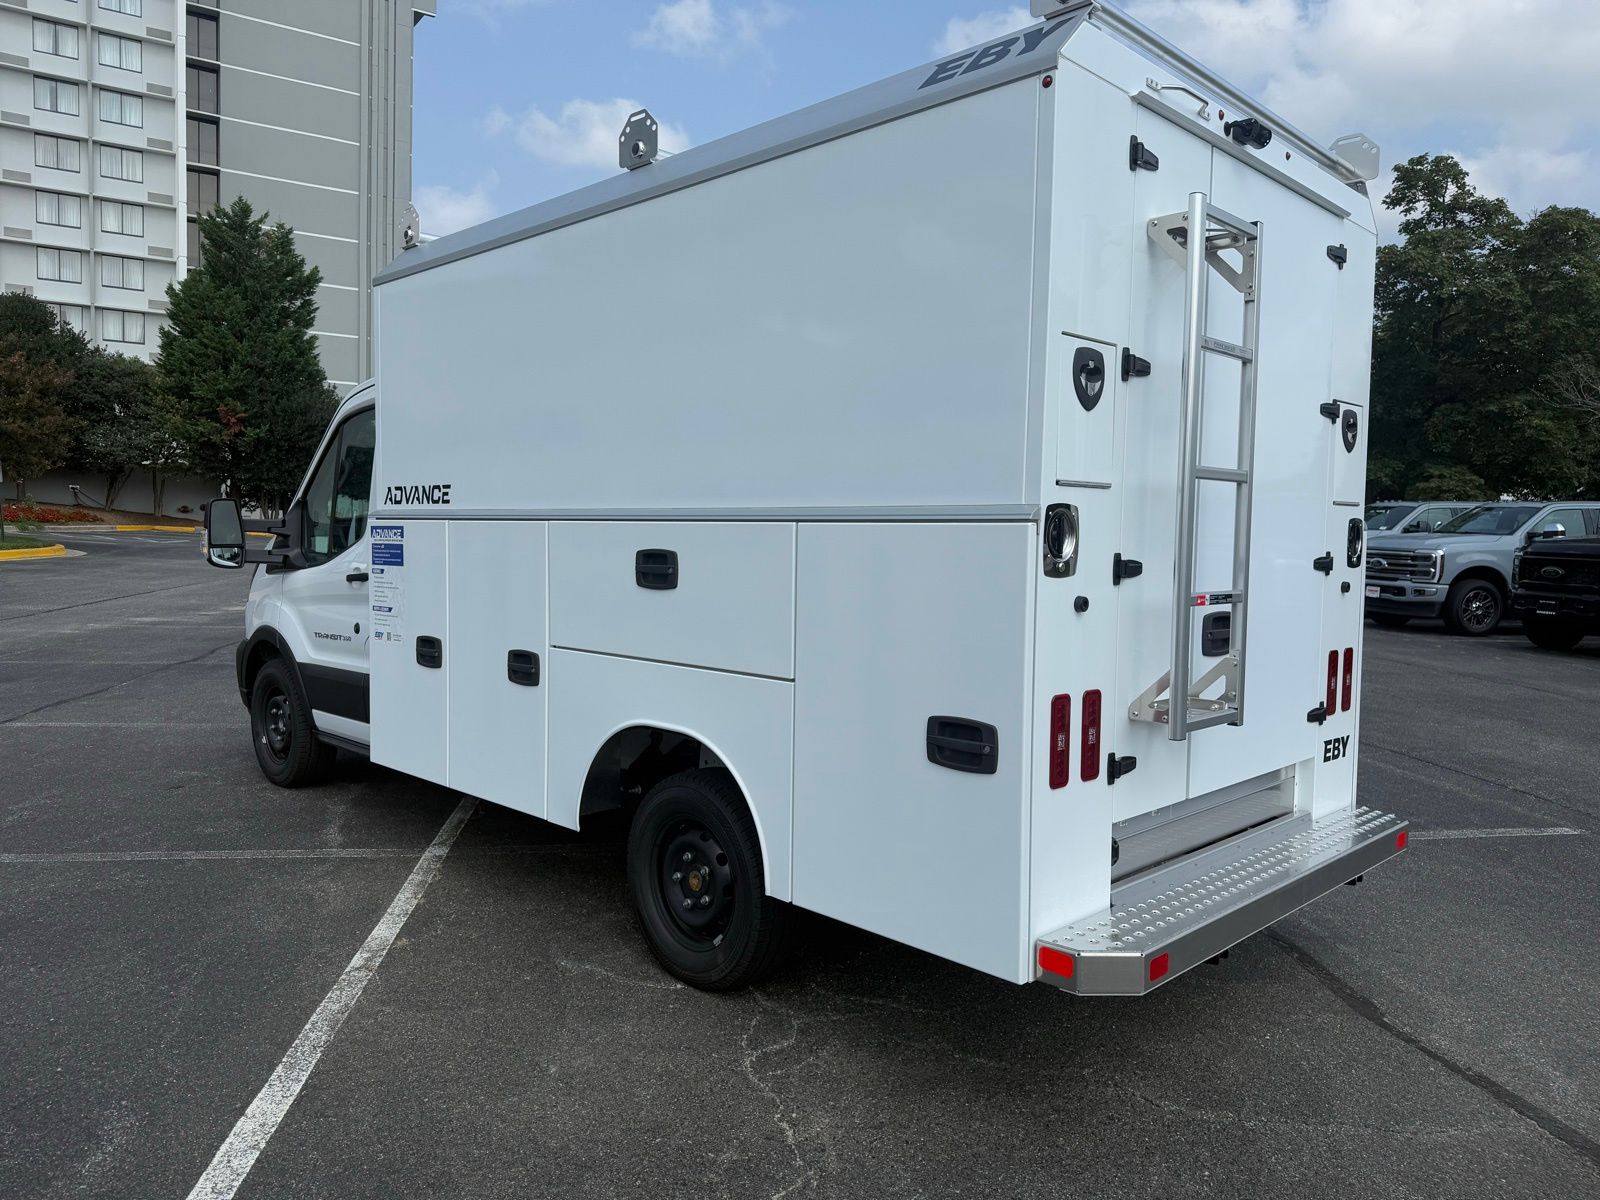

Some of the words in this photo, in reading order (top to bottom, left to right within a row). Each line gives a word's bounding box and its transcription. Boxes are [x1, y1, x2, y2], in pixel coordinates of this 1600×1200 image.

[917, 15, 1078, 90] EBY
[384, 484, 451, 505] ADVANCE
[372, 528, 402, 538] ADVANCE
[1323, 734, 1350, 763] EBY
